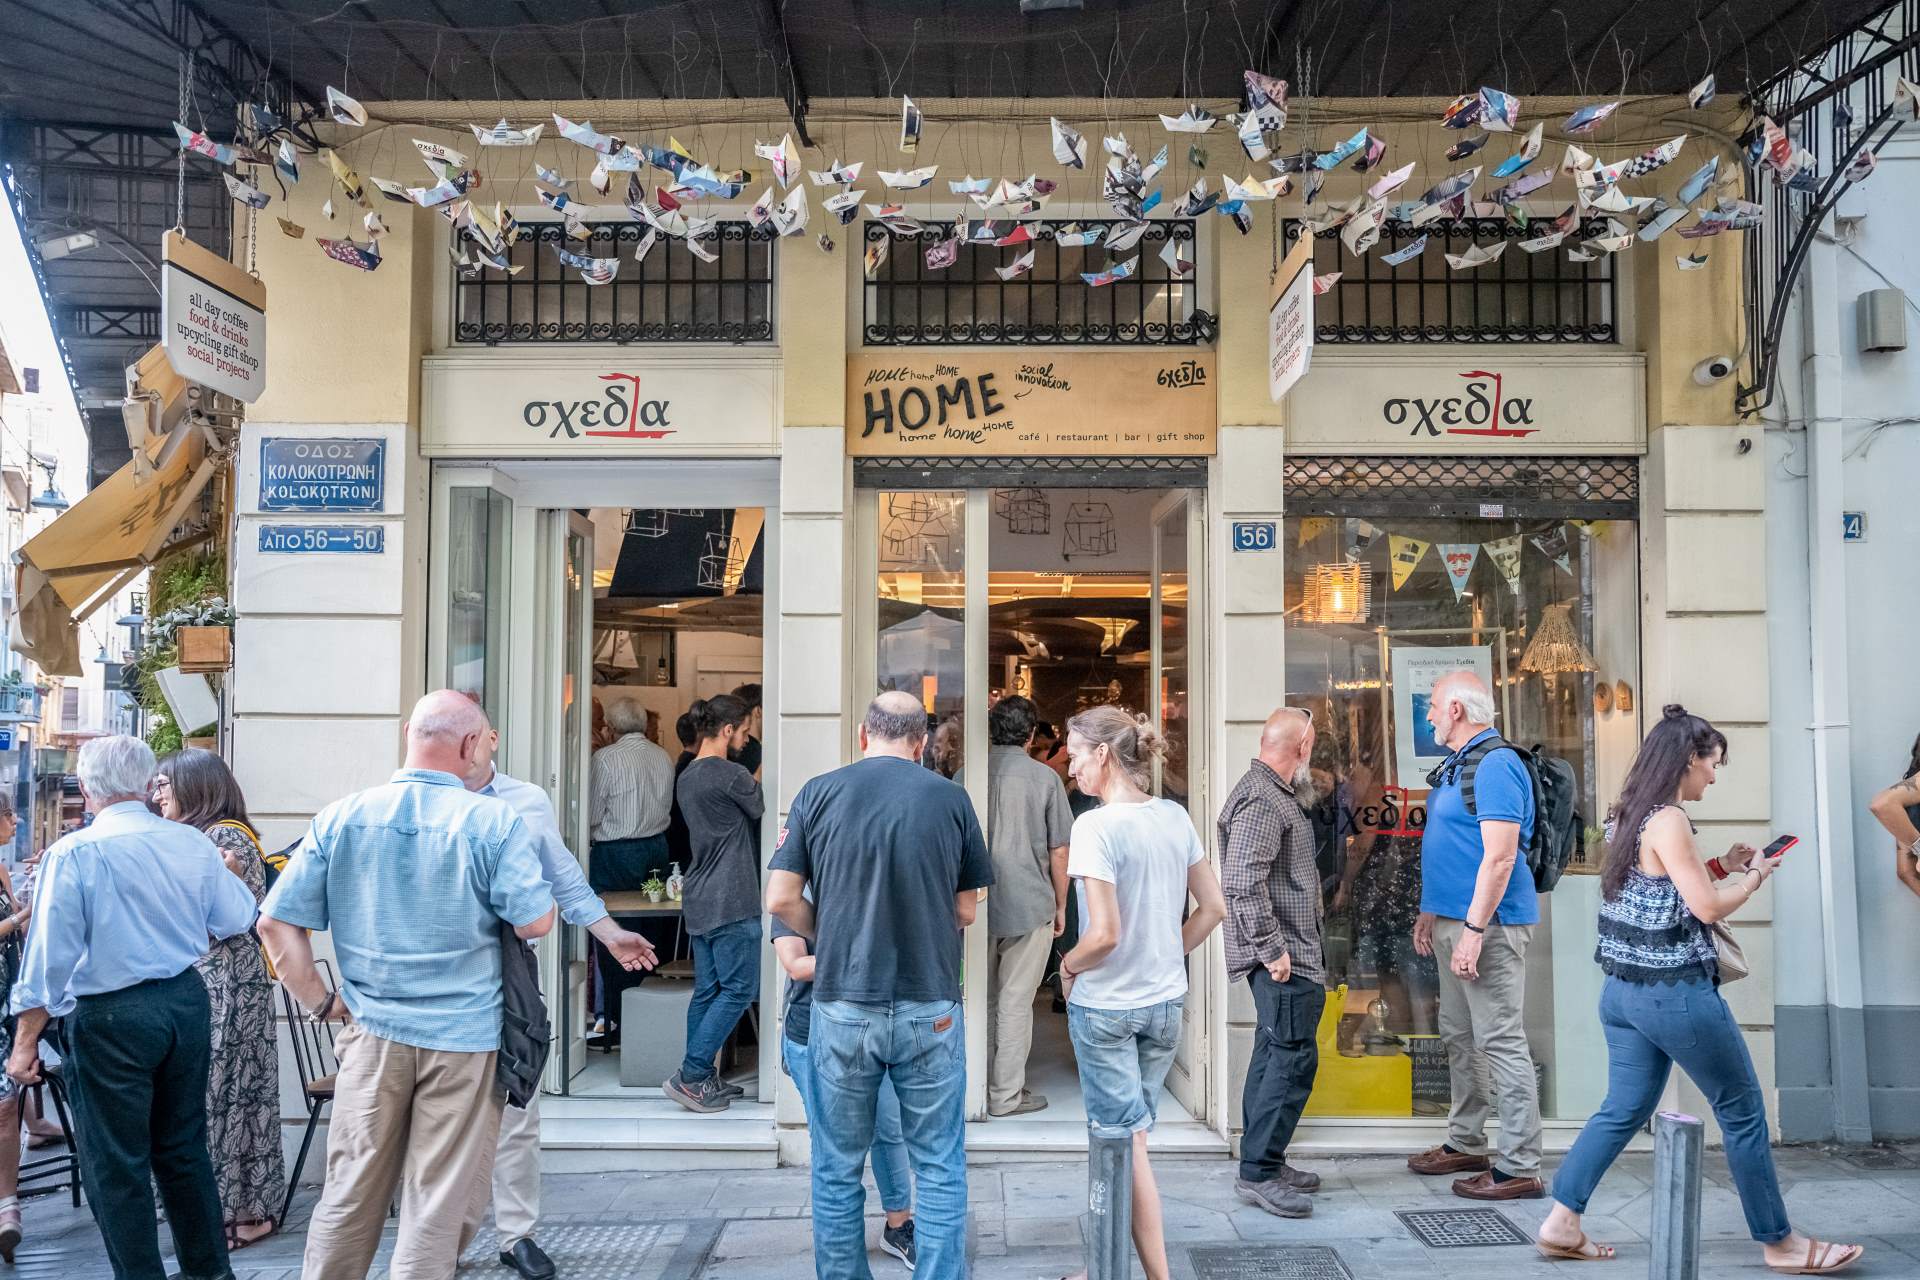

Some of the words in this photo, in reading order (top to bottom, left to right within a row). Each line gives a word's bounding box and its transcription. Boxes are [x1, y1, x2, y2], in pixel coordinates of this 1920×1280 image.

[189, 293, 202, 308] all
[204, 300, 221, 319] day
[222, 311, 249, 331] coffee
[189, 308, 210, 329] food
[211, 320, 219, 333] &
[221, 324, 249, 348] drinks
[177, 322, 222, 354] upcycling
[223, 343, 239, 359] gift
[240, 350, 259, 371] shop
[187, 345, 214, 365] social
[216, 357, 250, 380] projects
[1020, 362, 1054, 378] social
[864, 367, 909, 387] HOME
[910, 370, 935, 382] home
[936, 364, 960, 377] HOME
[1014, 370, 1072, 391] innovation
[862, 373, 1005, 438] HOME
[899, 431, 937, 442] home
[943, 423, 986, 444] home
[982, 421, 1015, 432] HOME
[1018, 432, 1040, 441] café
[1056, 433, 1109, 441] restaurant
[1124, 433, 1141, 441] bar
[1156, 432, 1178, 443] gift
[1183, 432, 1205, 444] shop
[295, 444, 355, 458] ΟΔΟΣ
[268, 464, 375, 480] ΚΟΛΟΚΟΤΡΩΝΗ
[268, 485, 375, 499] KOLOKOTRONI
[1241, 526, 1268, 547] 56
[1843, 517, 1860, 537] 4
[264, 534, 301, 549] ΑΠΟ
[304, 529, 328, 549] 56
[353, 529, 378, 549] 50
